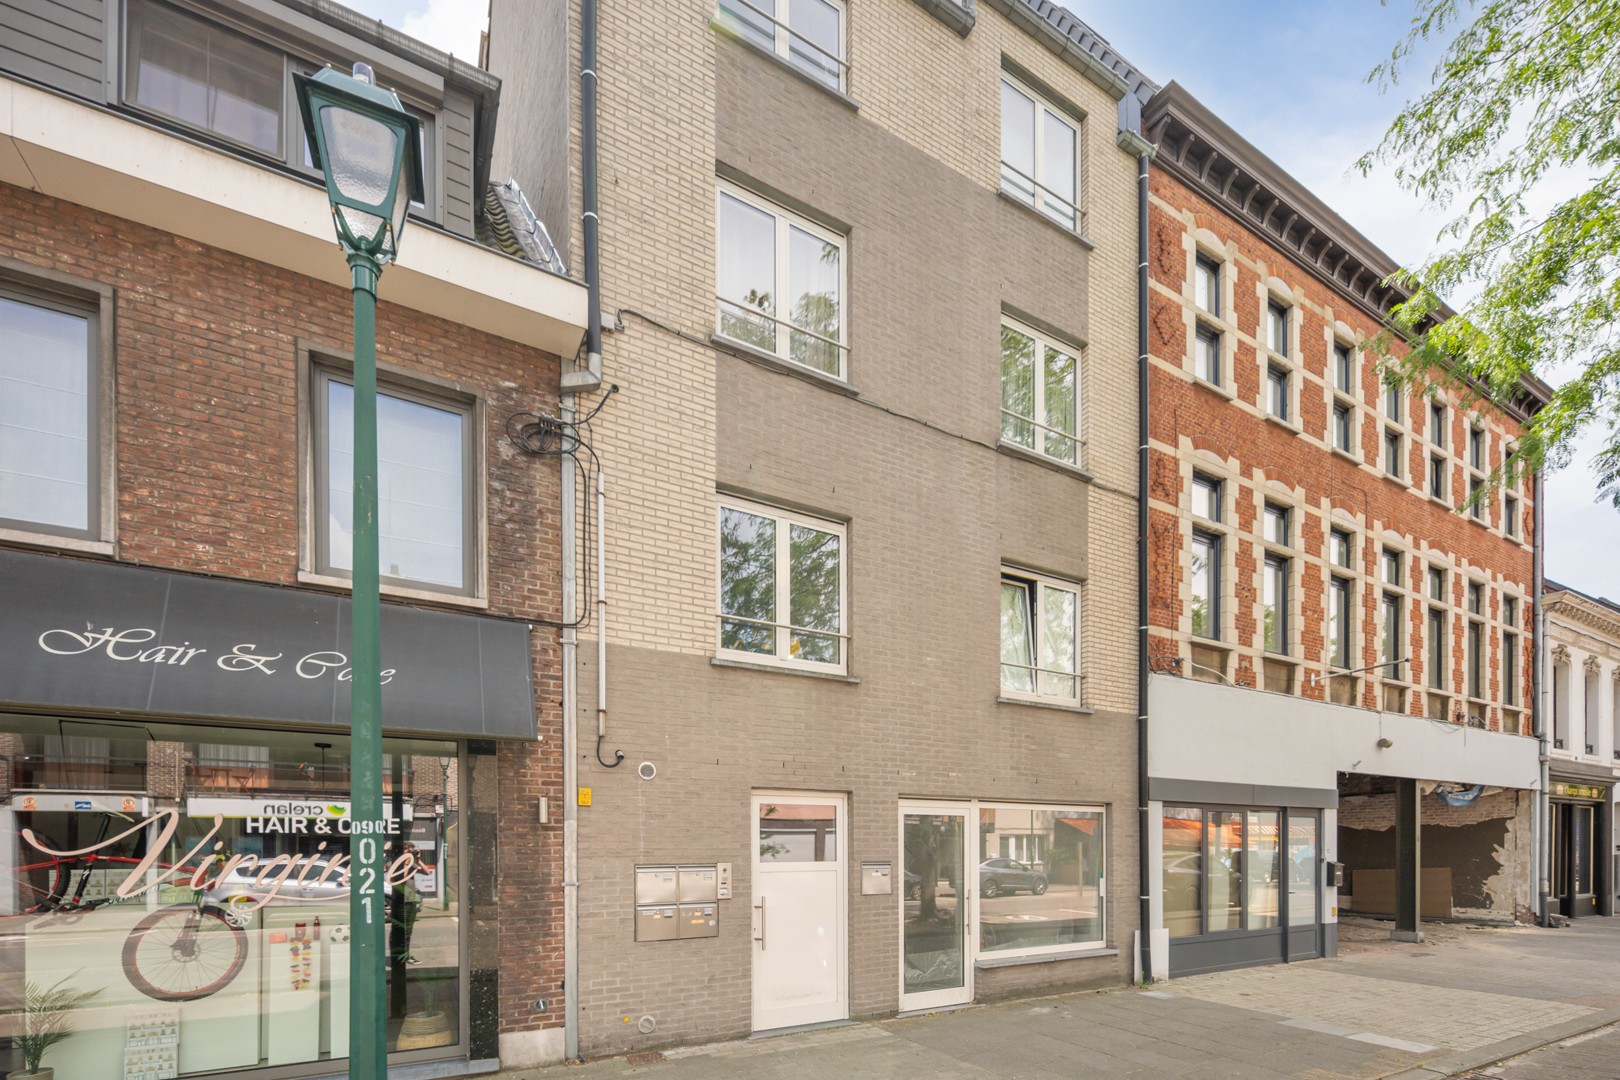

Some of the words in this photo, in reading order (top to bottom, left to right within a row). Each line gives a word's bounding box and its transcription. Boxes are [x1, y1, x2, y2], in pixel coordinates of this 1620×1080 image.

[38, 628, 207, 666] Hair
[217, 644, 282, 675] &
[246, 816, 308, 834] HAIR
[314, 817, 332, 834] &
